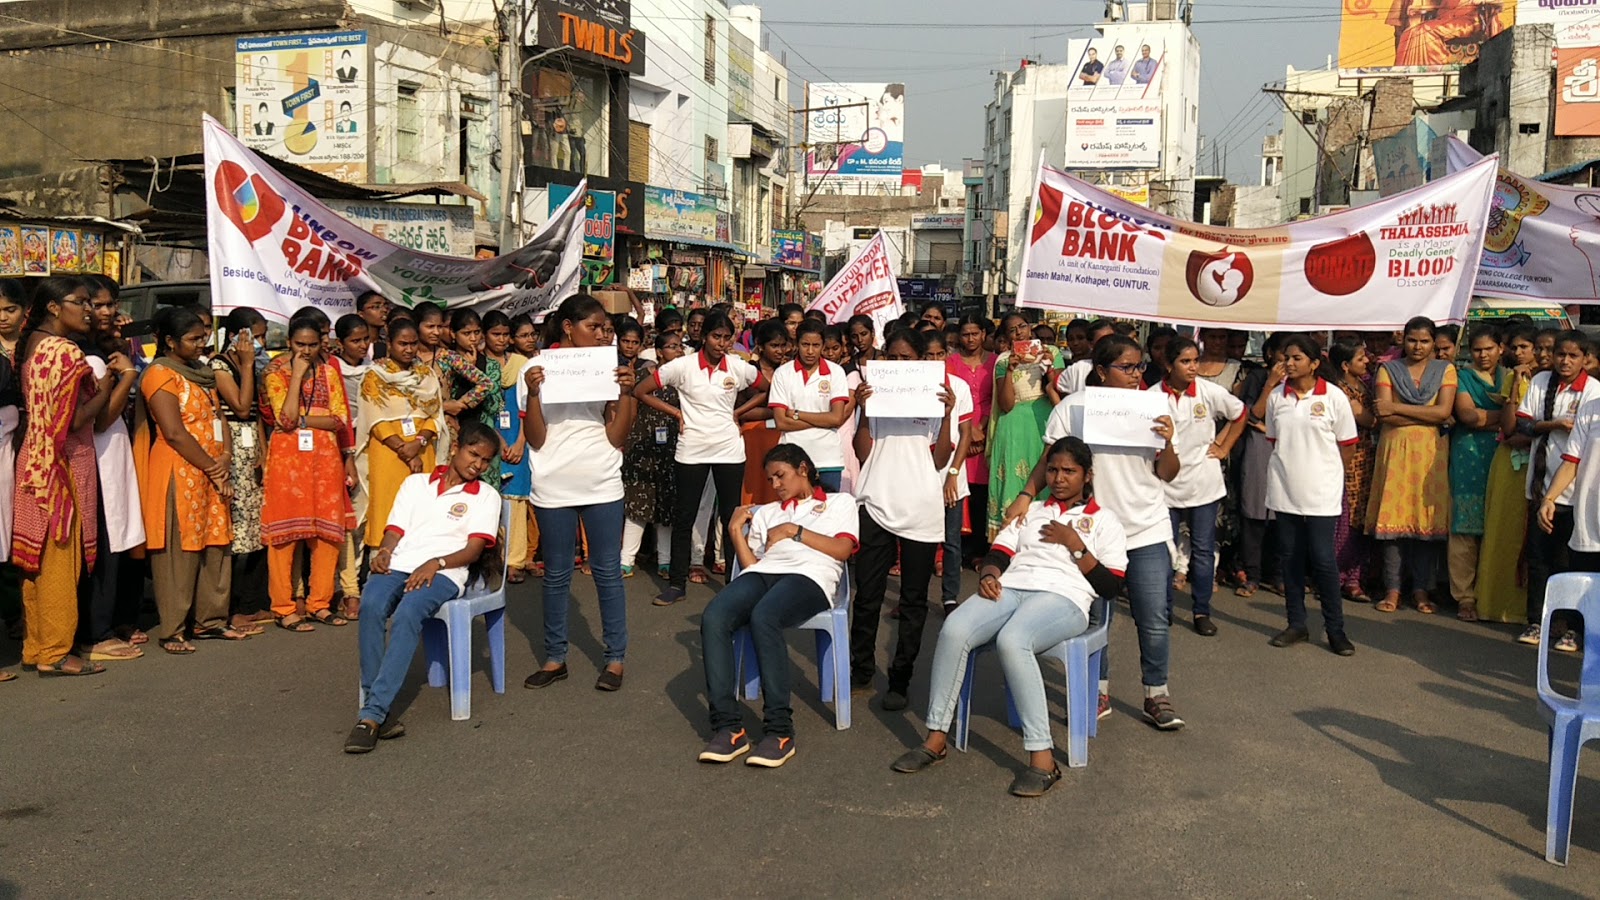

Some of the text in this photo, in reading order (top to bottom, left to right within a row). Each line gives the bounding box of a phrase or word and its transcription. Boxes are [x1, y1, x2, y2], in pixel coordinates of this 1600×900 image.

[299, 88, 315, 100] FIRST
[346, 206, 398, 220] SWASTIK
[1380, 222, 1469, 240] THALASSEMIA
[1062, 229, 1138, 262] BANK
[1424, 239, 1454, 250] Major
[1389, 248, 1423, 259] Deadly
[1066, 261, 1079, 269] unit
[1388, 255, 1455, 278] BLOOD
[223, 266, 255, 280] Beside
[1493, 270, 1522, 281] COLLEGE
[1534, 276, 1553, 284] WOMEN
[1050, 271, 1073, 283] Mahal,
[1075, 274, 1111, 288] Kothapet,
[1113, 278, 1151, 291] GUNTUR.
